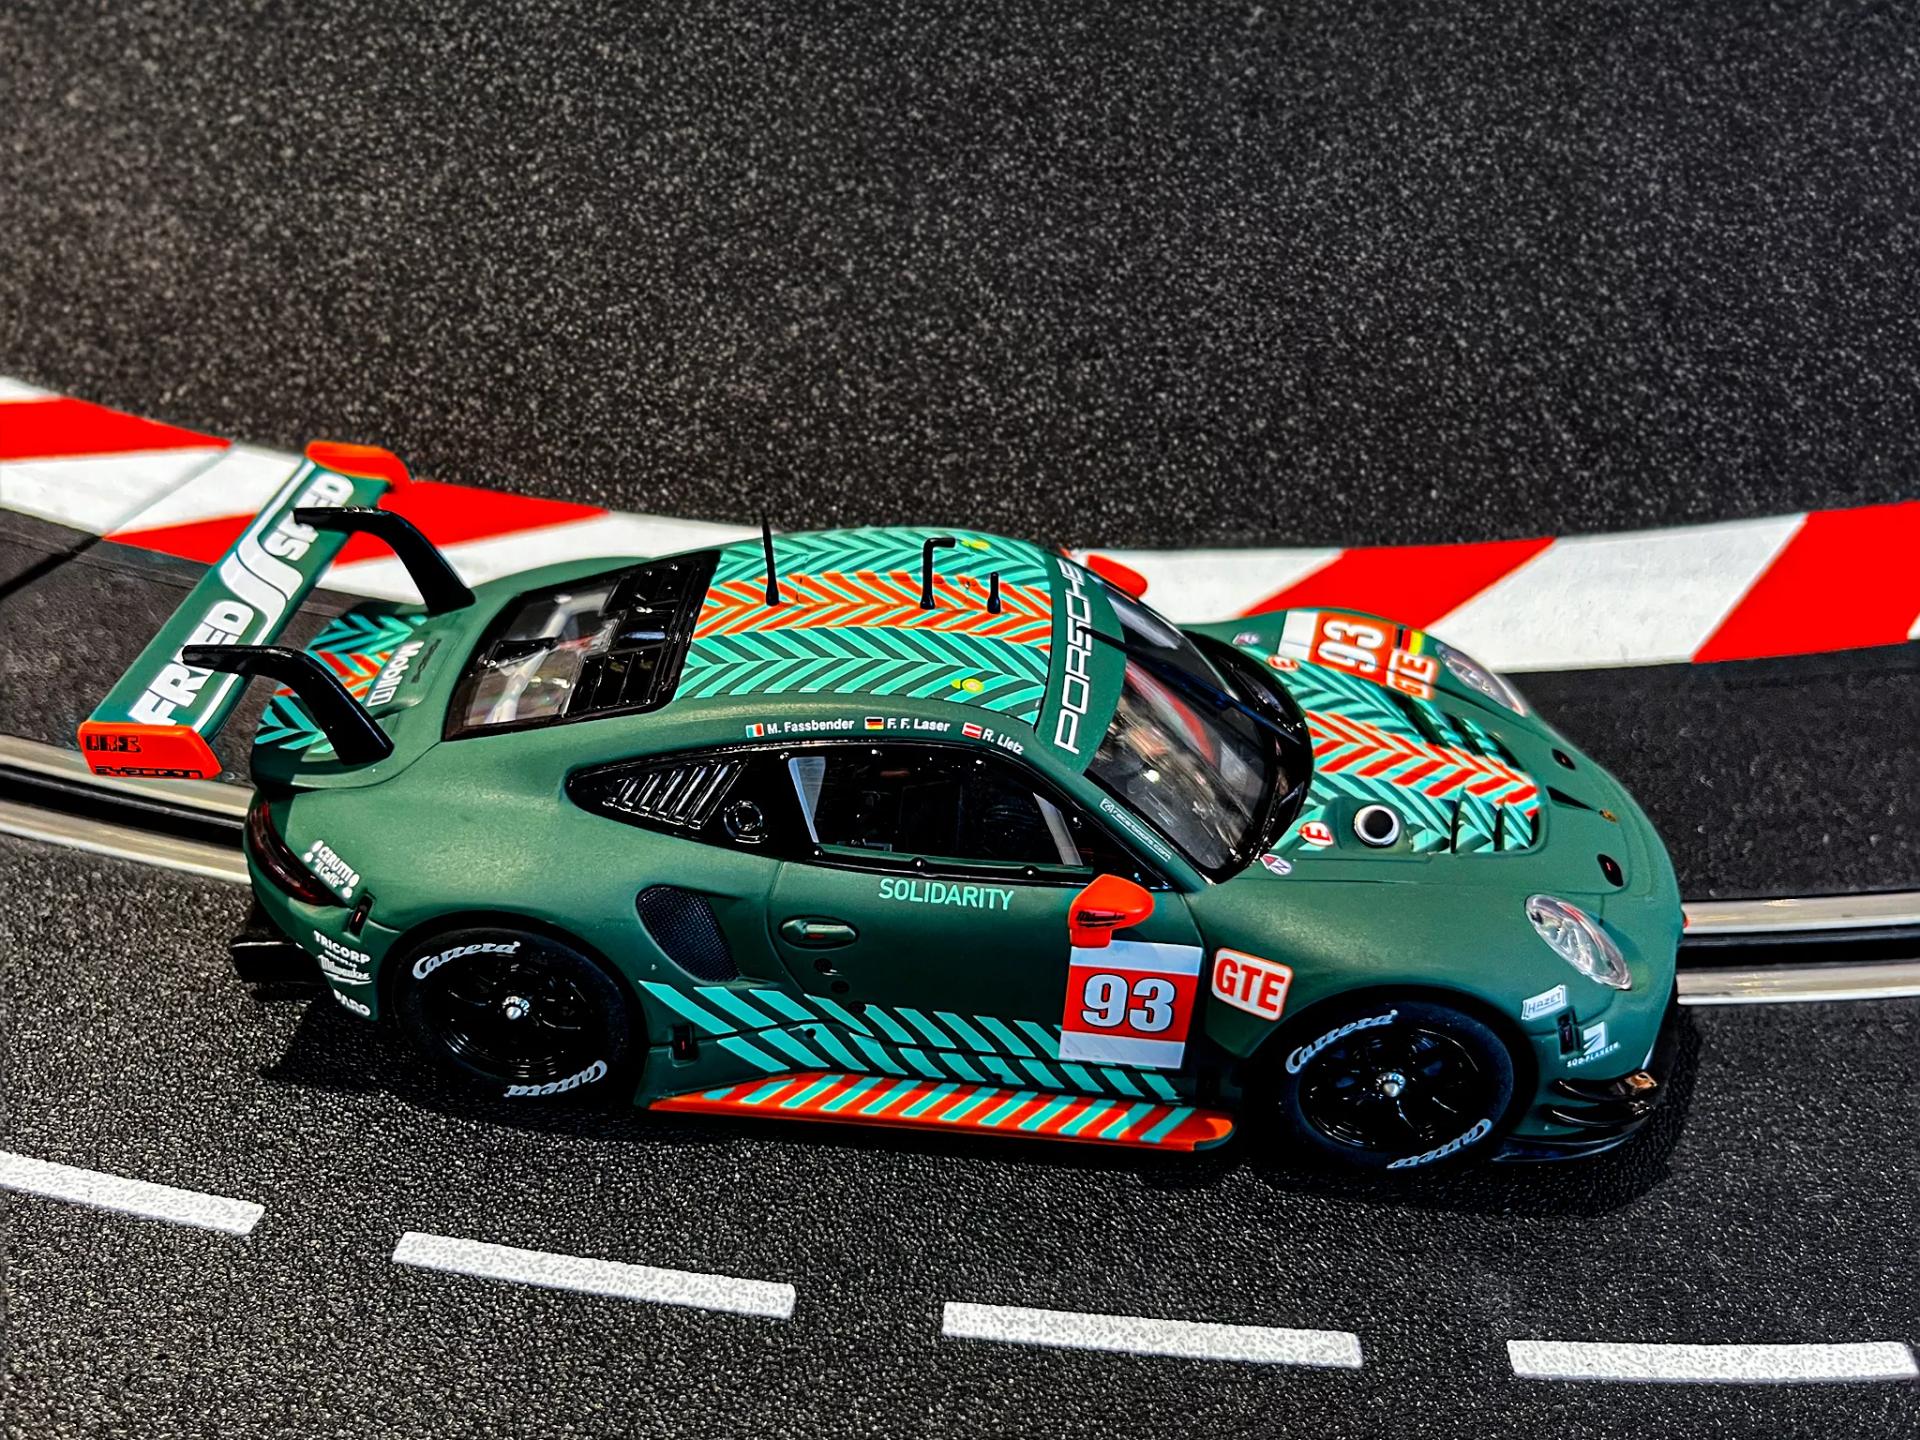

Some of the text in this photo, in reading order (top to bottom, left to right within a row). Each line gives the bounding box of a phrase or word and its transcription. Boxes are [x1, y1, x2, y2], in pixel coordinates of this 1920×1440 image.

[1053, 558, 1091, 755] PORSCHE
[1317, 620, 1384, 673] 93
[1391, 653, 1429, 696] GTE
[766, 718, 855, 735] M. Fassbender
[887, 718, 951, 732] F. F. Laser
[982, 728, 1025, 755] R. Lietz
[318, 846, 355, 882] CERUTTI
[879, 878, 1014, 910] SOLIDARITY
[314, 930, 371, 964] TRICORP
[412, 941, 520, 979] Carrera
[1081, 973, 1177, 1032] 93
[1215, 958, 1286, 1012] GTE
[1527, 993, 1561, 1013] HAZET
[1285, 1009, 1397, 1074] Carrera
[504, 1060, 607, 1097] Carrera
[1387, 1119, 1492, 1169] Carrera
